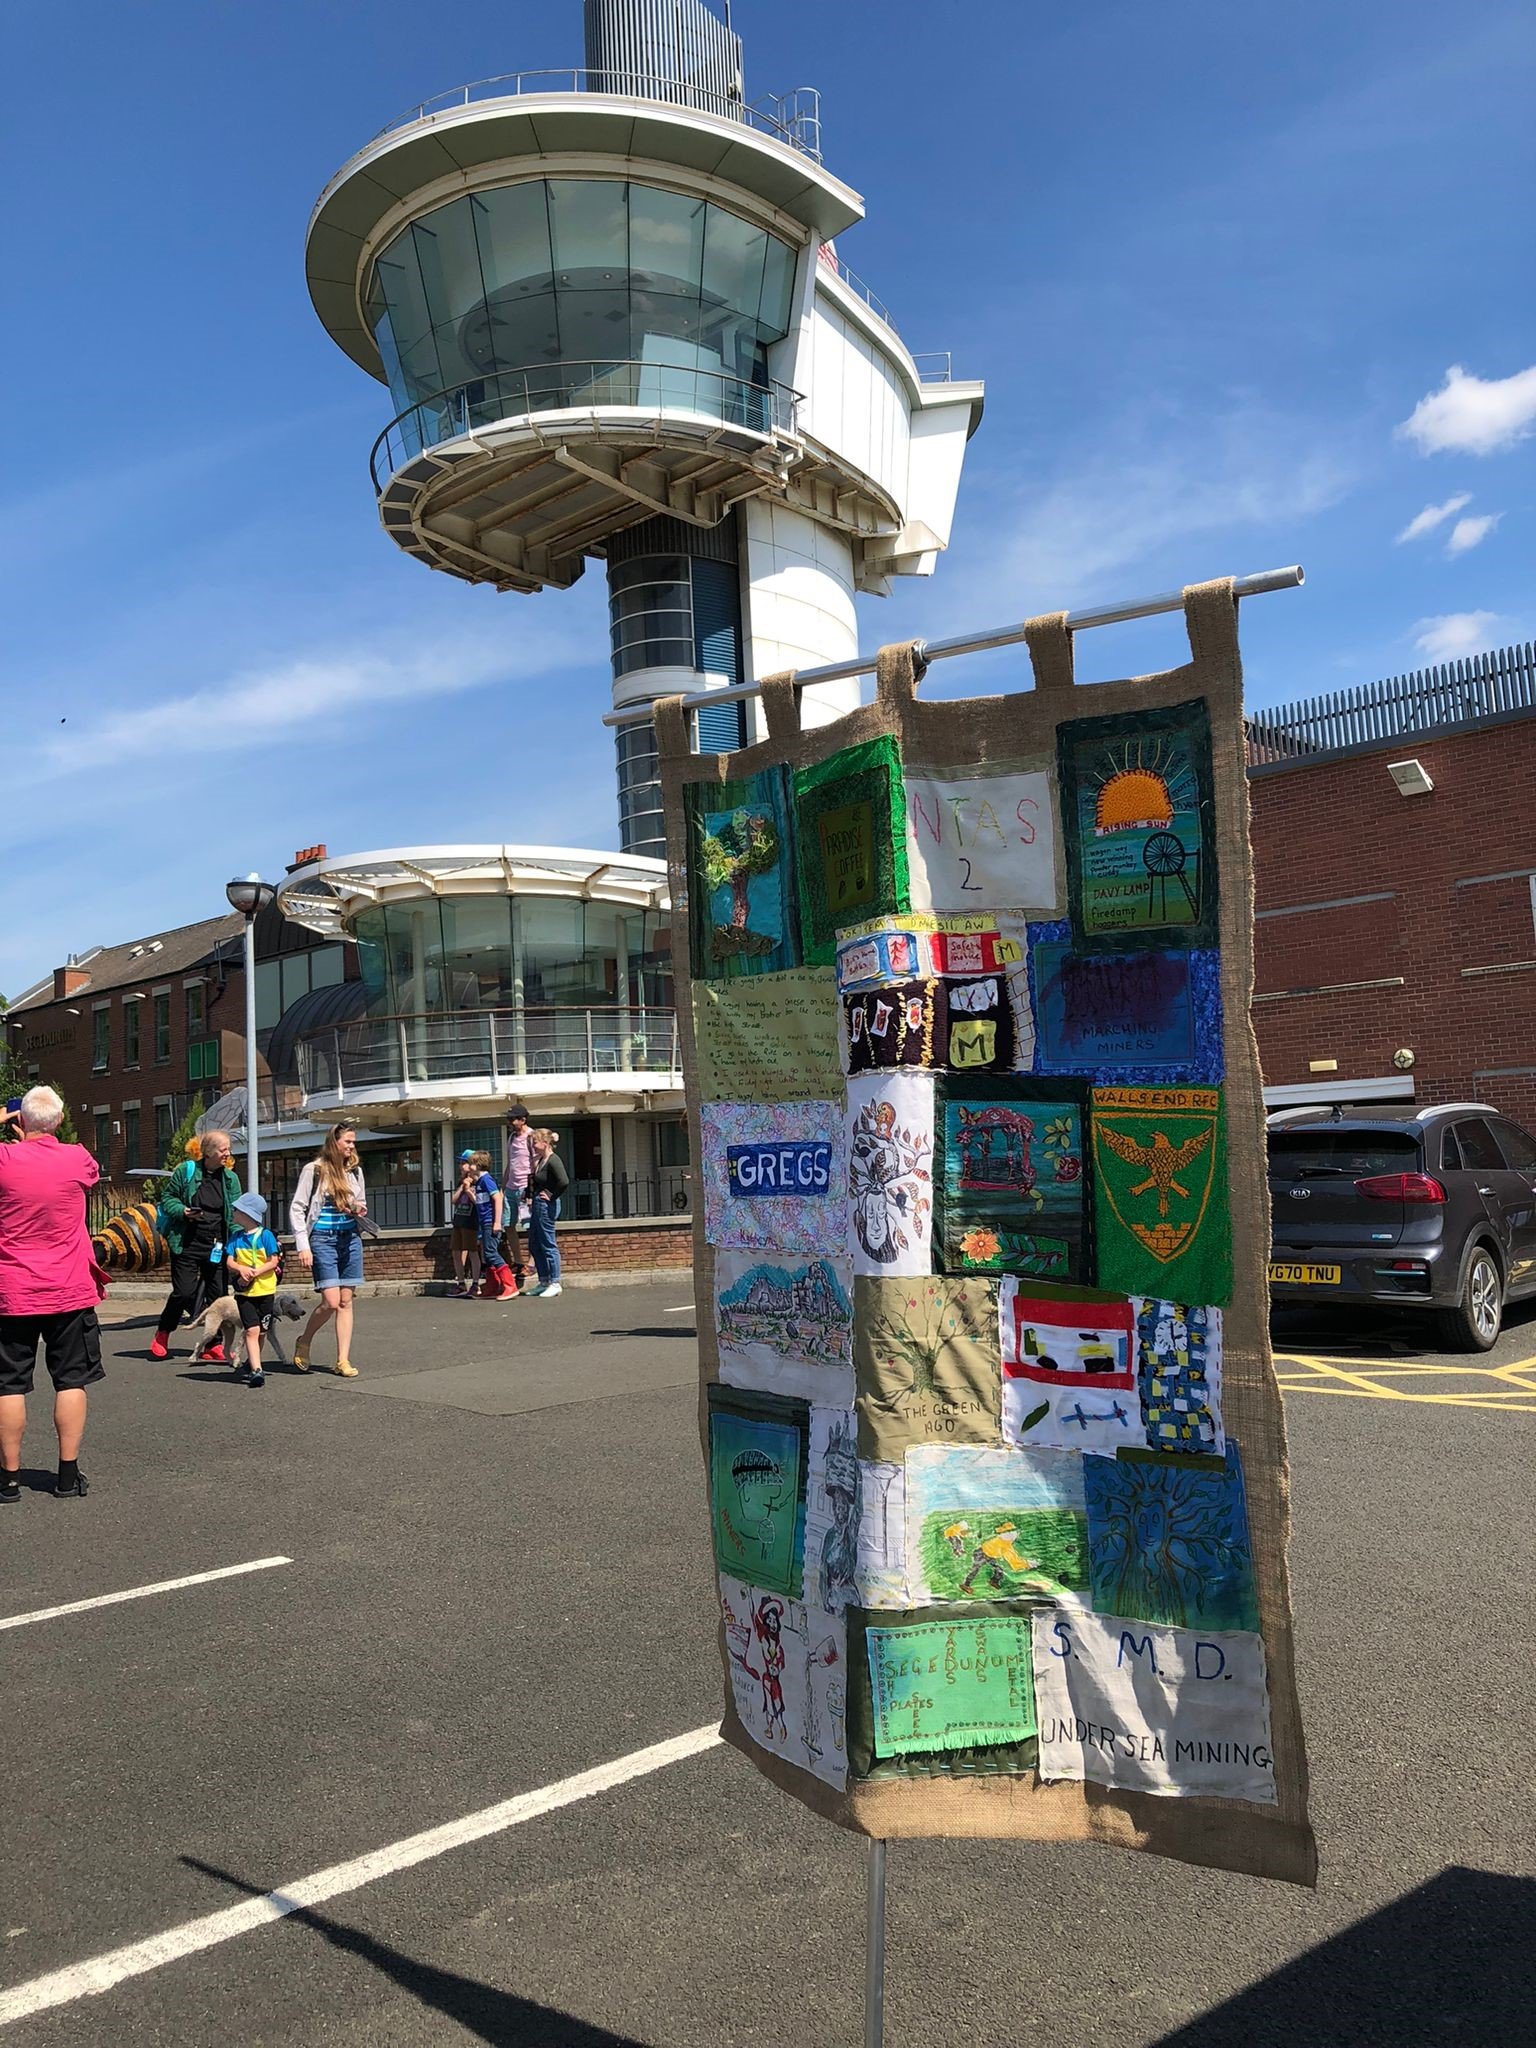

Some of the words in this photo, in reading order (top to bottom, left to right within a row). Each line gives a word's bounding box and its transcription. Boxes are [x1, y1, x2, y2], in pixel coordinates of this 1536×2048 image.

[1103, 821, 1137, 834] RISING
[1146, 820, 1167, 829] SUN
[957, 858, 983, 891] 2
[1094, 886, 1120, 900] DAVY
[1124, 883, 1150, 896] LAMP
[1092, 906, 1137, 921] firedamp
[1083, 1023, 1158, 1040] MARCHING
[957, 1033, 987, 1062] M
[1097, 1039, 1155, 1054] MINERS
[1192, 1094, 1217, 1107] RFC
[737, 1148, 828, 1187] GREGS
[1293, 1189, 1307, 1197] KIA
[1268, 1265, 1302, 1280] YG70
[1307, 1267, 1334, 1281] TNU
[902, 1404, 927, 1419] THE
[933, 1401, 981, 1416] GREEN
[890, 1698, 934, 1712] PLATES
[1041, 1718, 1115, 1753] UNDER
[1124, 1735, 1165, 1762] SEA
[1175, 1739, 1273, 1769] MINING
